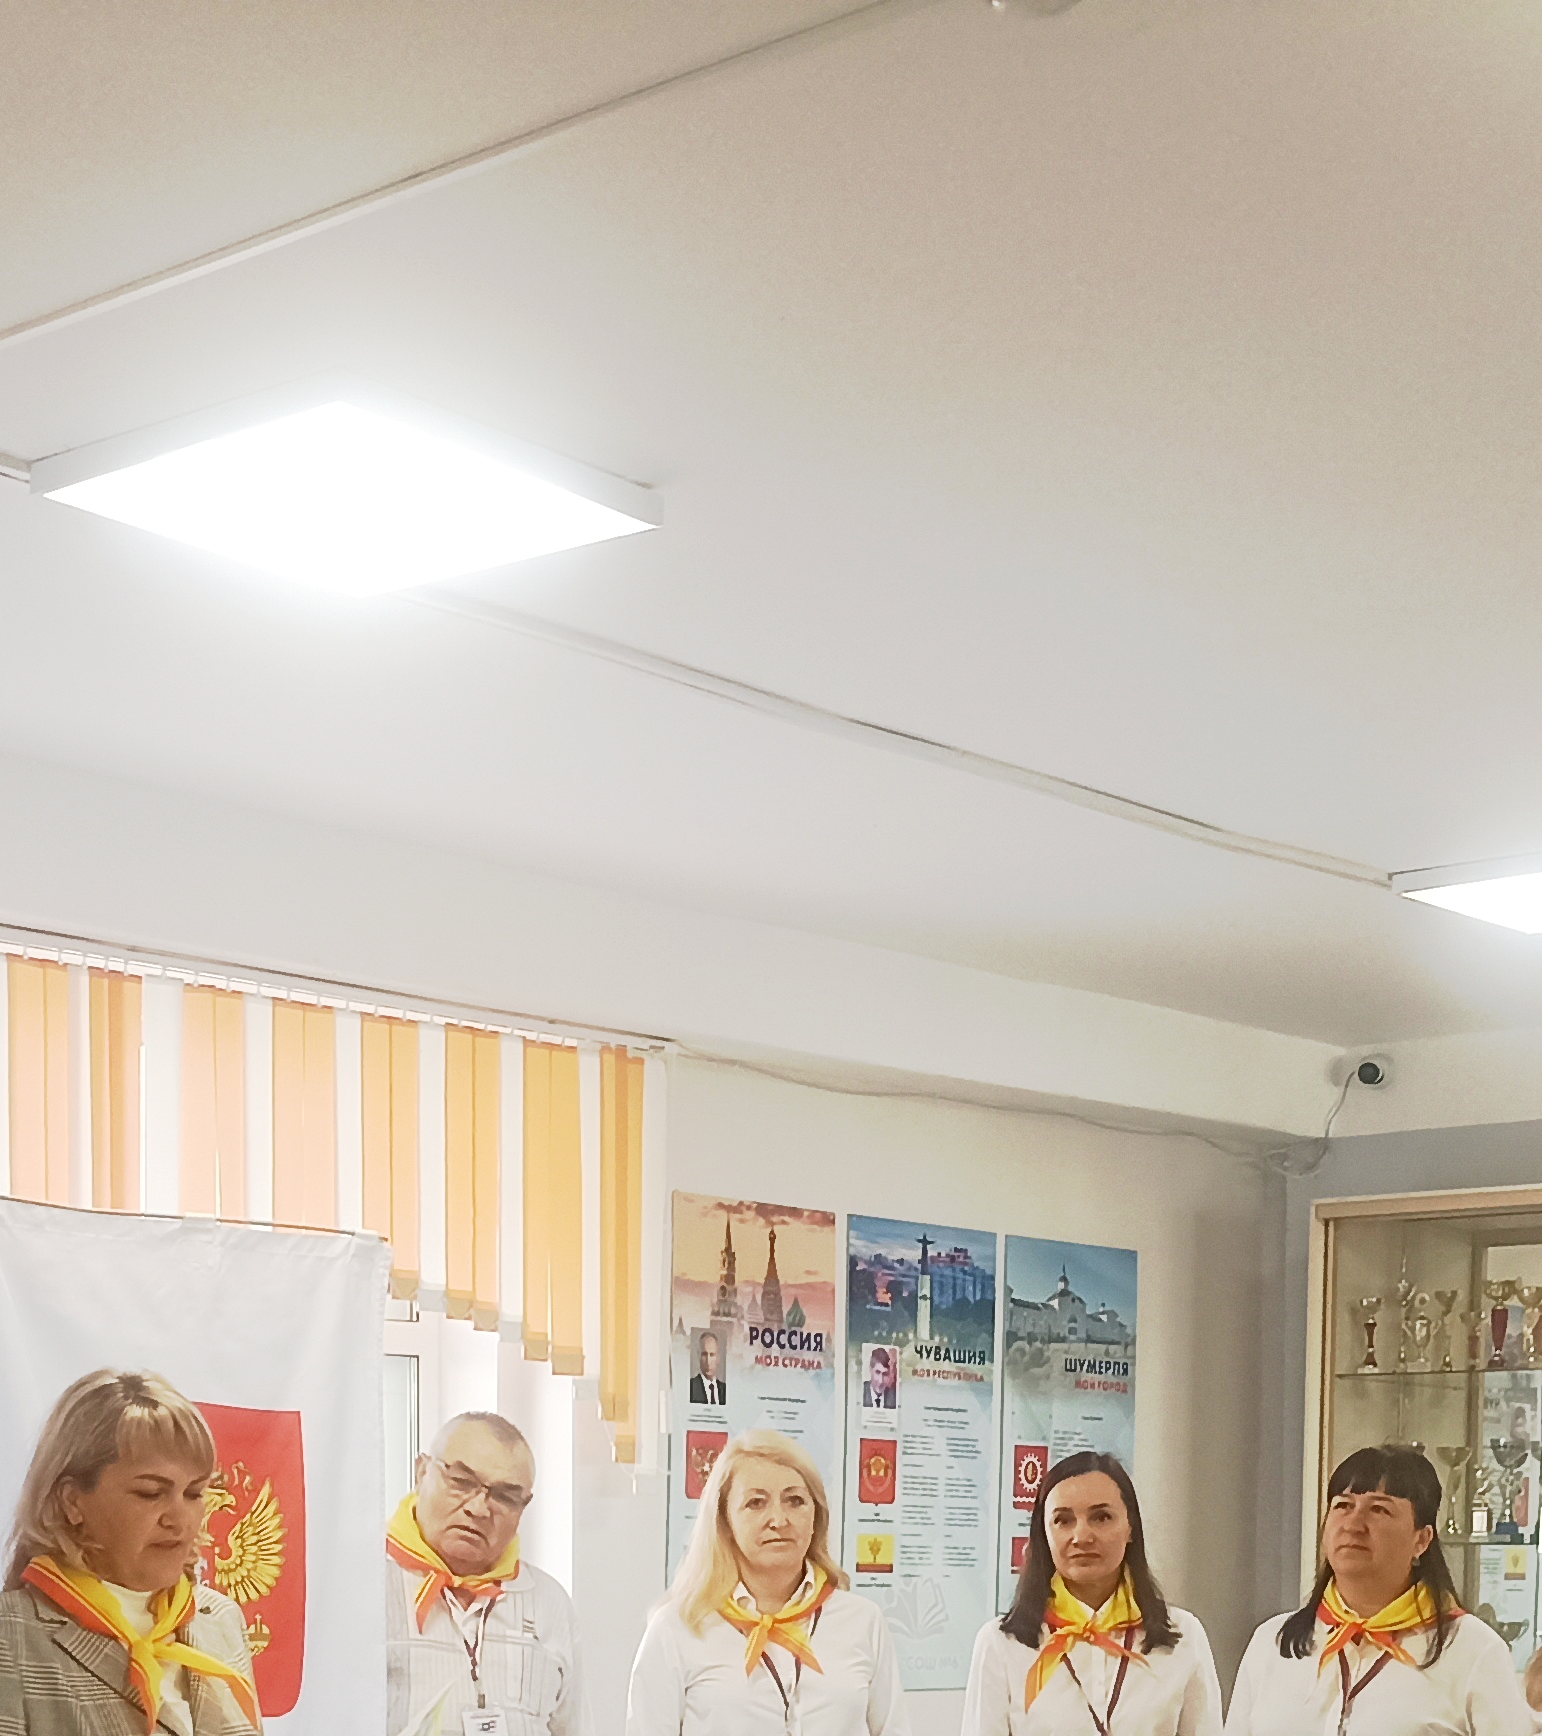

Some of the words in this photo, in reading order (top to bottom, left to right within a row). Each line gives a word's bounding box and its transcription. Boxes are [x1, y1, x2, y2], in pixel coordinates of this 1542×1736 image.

[749, 1326, 823, 1352] РОССИЯ
[755, 1354, 779, 1367] МОЯ
[781, 1356, 822, 1370] СТРАНА
[915, 1344, 986, 1366] ЧУВАШИЯ
[1065, 1357, 1129, 1376] ШУМЕРЛЯ
